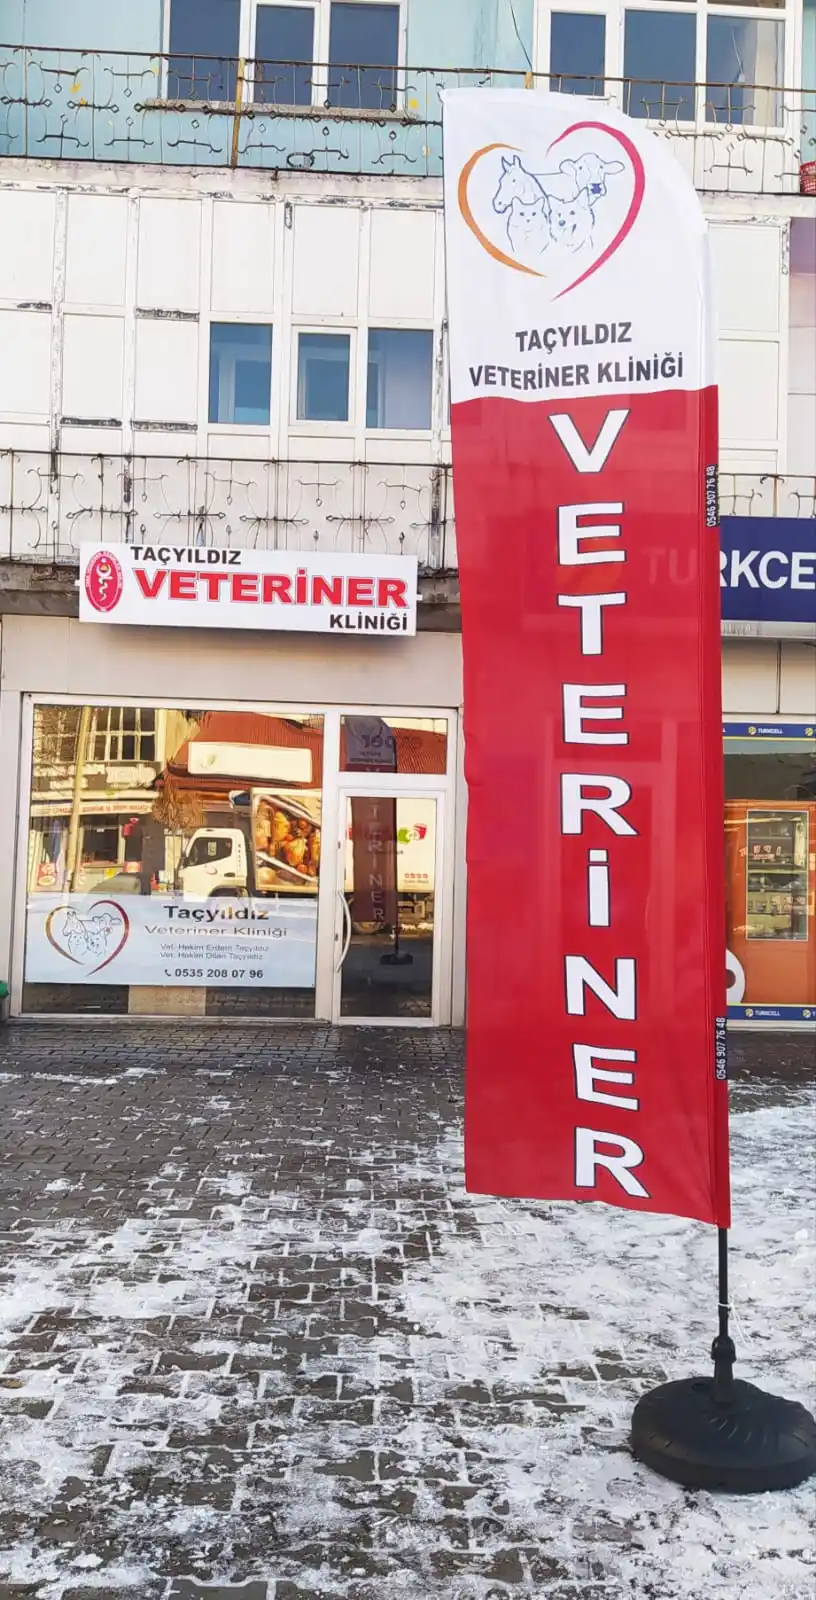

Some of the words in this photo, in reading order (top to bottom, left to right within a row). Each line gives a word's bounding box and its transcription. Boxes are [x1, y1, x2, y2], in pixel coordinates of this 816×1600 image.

[515, 321, 632, 355] TAÇYILDIZ
[468, 363, 590, 391] VETERİNER
[597, 351, 684, 384] KLİNİĞİ
[130, 546, 242, 566] TAÇYILDIZ
[132, 566, 410, 609] VETERİNER
[329, 612, 409, 631] KLİNİĞİ
[547, 408, 650, 1199] VETERİNER
[164, 905, 270, 923] Taçyıldız
[144, 925, 227, 936] Veteriner
[233, 926, 288, 938] Kliniği
[174, 968, 204, 978] 0535
[206, 969, 228, 978] 208
[231, 969, 246, 978] 07
[249, 969, 264, 979] 96
[715, 1017, 726, 1029] 48
